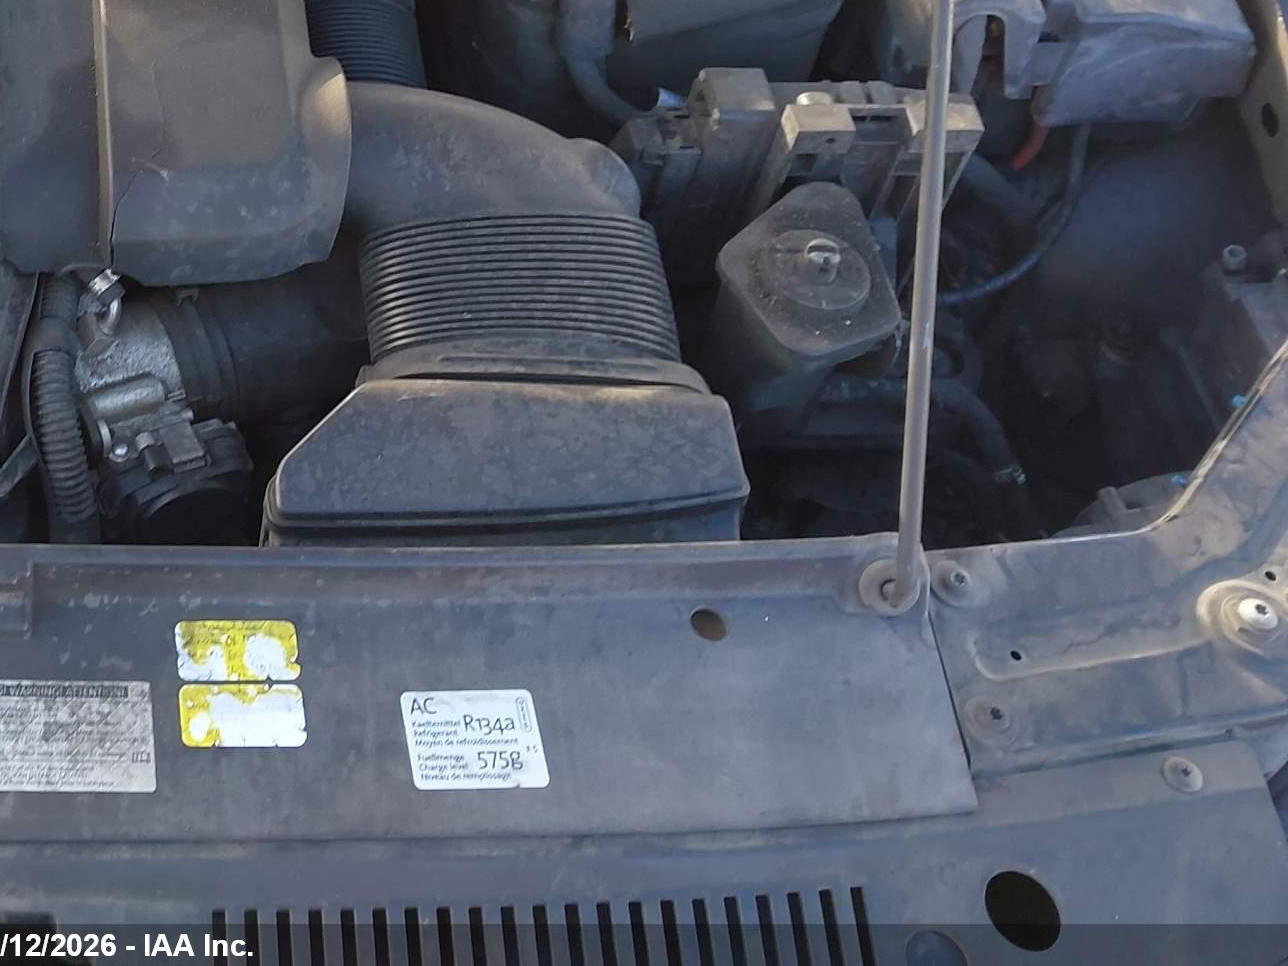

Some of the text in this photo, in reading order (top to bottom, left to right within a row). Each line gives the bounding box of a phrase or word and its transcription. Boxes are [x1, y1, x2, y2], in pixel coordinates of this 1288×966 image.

[410, 697, 437, 715] AC
[463, 714, 516, 736] R134a
[477, 750, 524, 771] 575g
